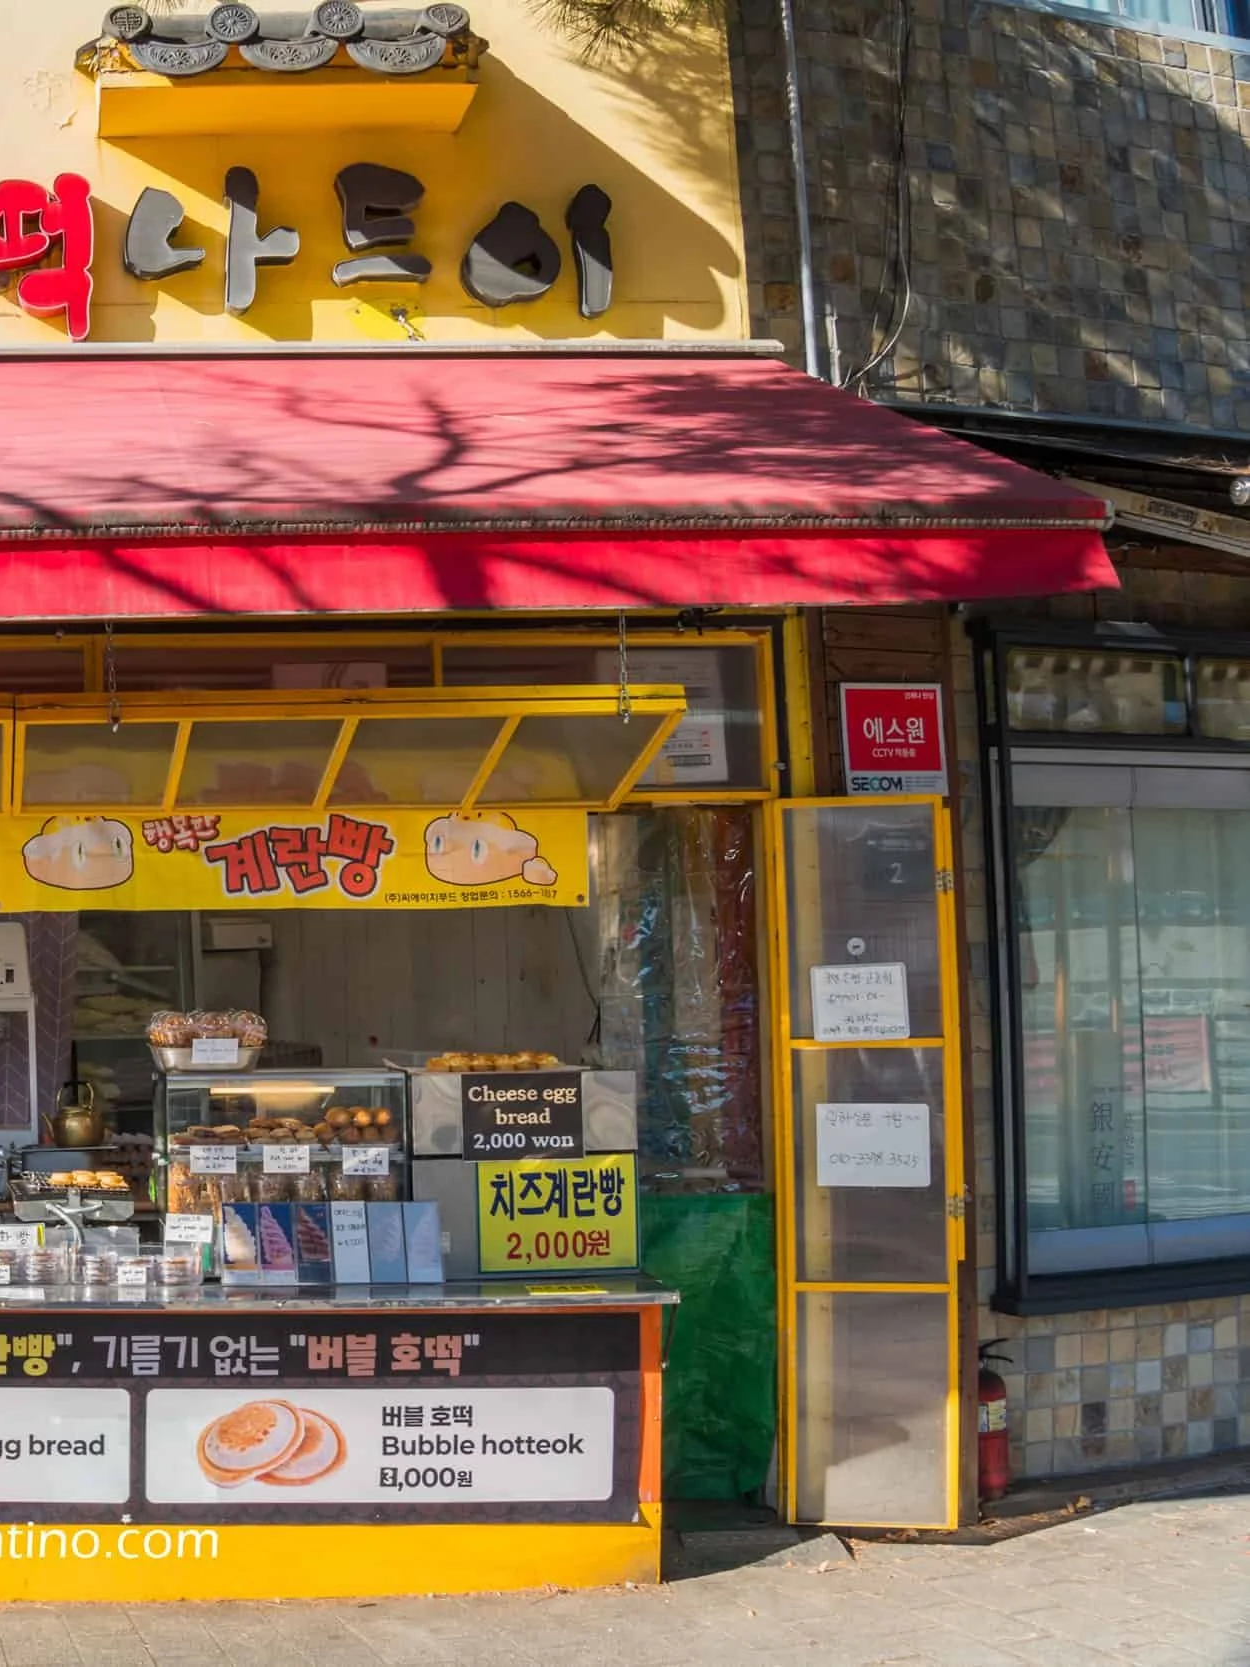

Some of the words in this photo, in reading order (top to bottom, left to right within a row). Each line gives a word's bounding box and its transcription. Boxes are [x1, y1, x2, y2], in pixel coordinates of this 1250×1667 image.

[863, 717, 926, 744] 에스원
[871, 747, 893, 758] CCTV
[851, 776, 903, 792] SECOM
[204, 814, 395, 898] 계란빵
[468, 1086, 538, 1102] Cheese
[543, 1087, 577, 1104] egg
[495, 1108, 551, 1125] bread
[473, 1133, 526, 1149] 2,000
[532, 1134, 575, 1148] won
[489, 1167, 625, 1221] 치즈계란빵
[506, 1228, 610, 1264] 2,000원
[93, 1335, 199, 1376] 기름기
[209, 1334, 280, 1376] 없는
[382, 1404, 425, 1428] 버블
[430, 1404, 474, 1428] 호떡
[28, 1432, 105, 1456] bread
[381, 1433, 475, 1456] Bubble
[481, 1433, 585, 1455] hotteok
